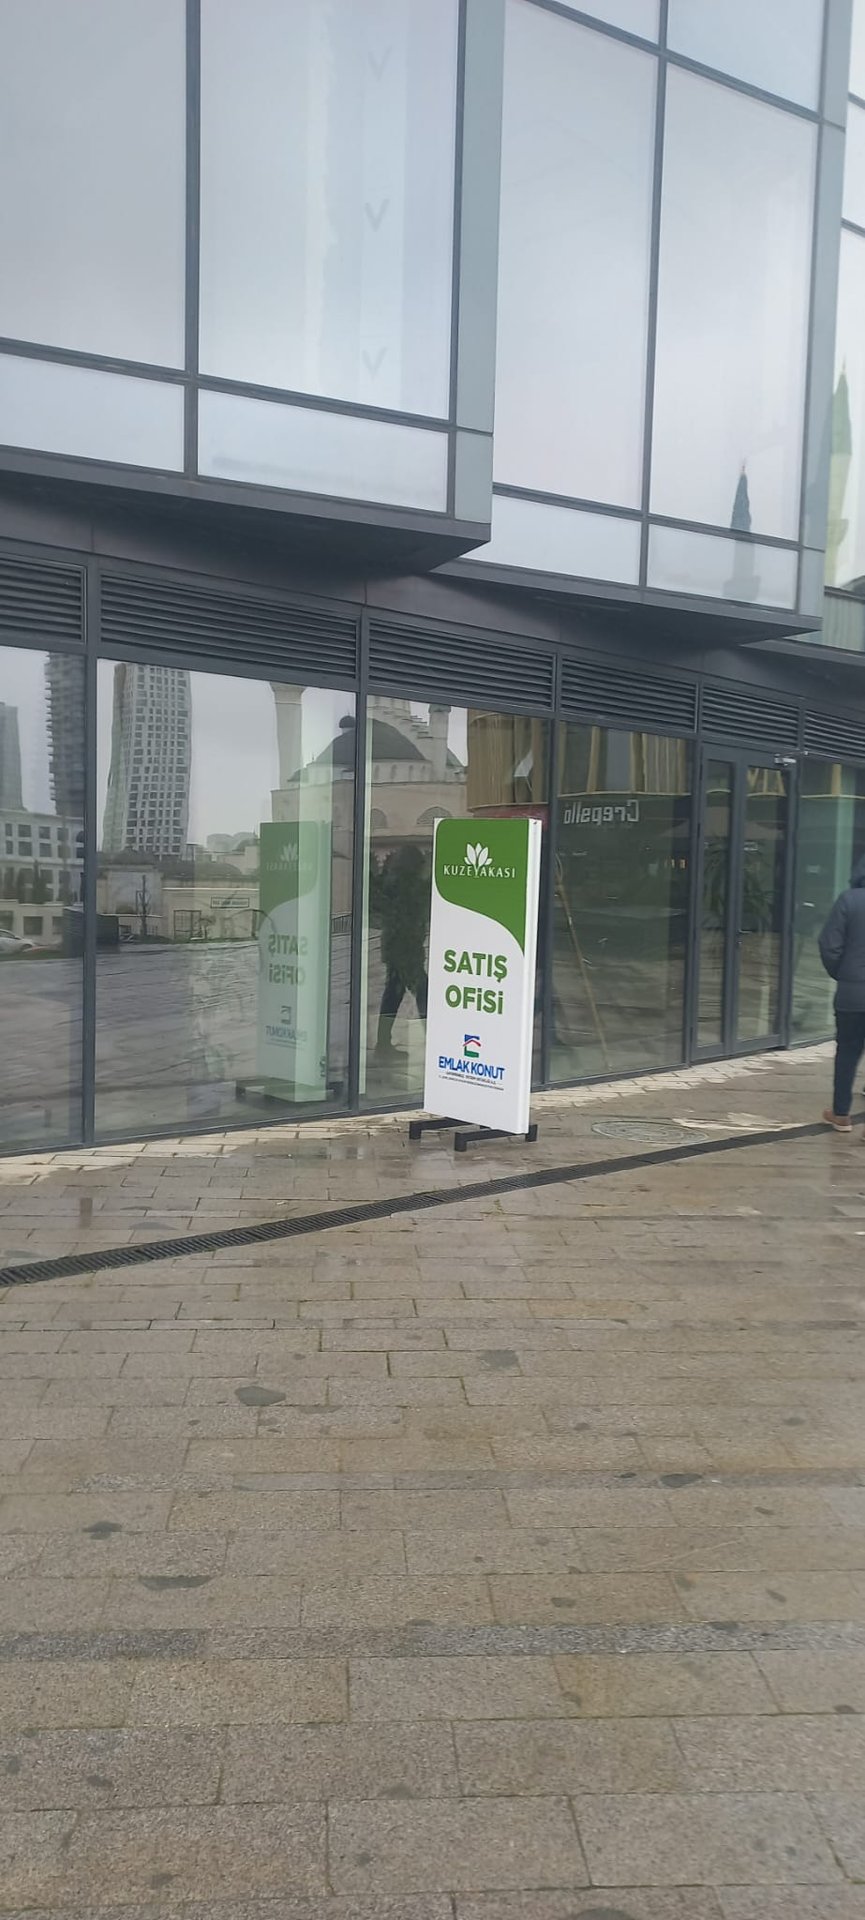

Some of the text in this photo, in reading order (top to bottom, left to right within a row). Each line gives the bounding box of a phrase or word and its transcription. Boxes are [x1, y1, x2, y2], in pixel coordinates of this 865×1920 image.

[443, 864, 516, 878] KUZEYAKASI
[443, 949, 508, 983] SATIŞ
[438, 1055, 470, 1073] EMLAK
[471, 1061, 505, 1080] KONUT
